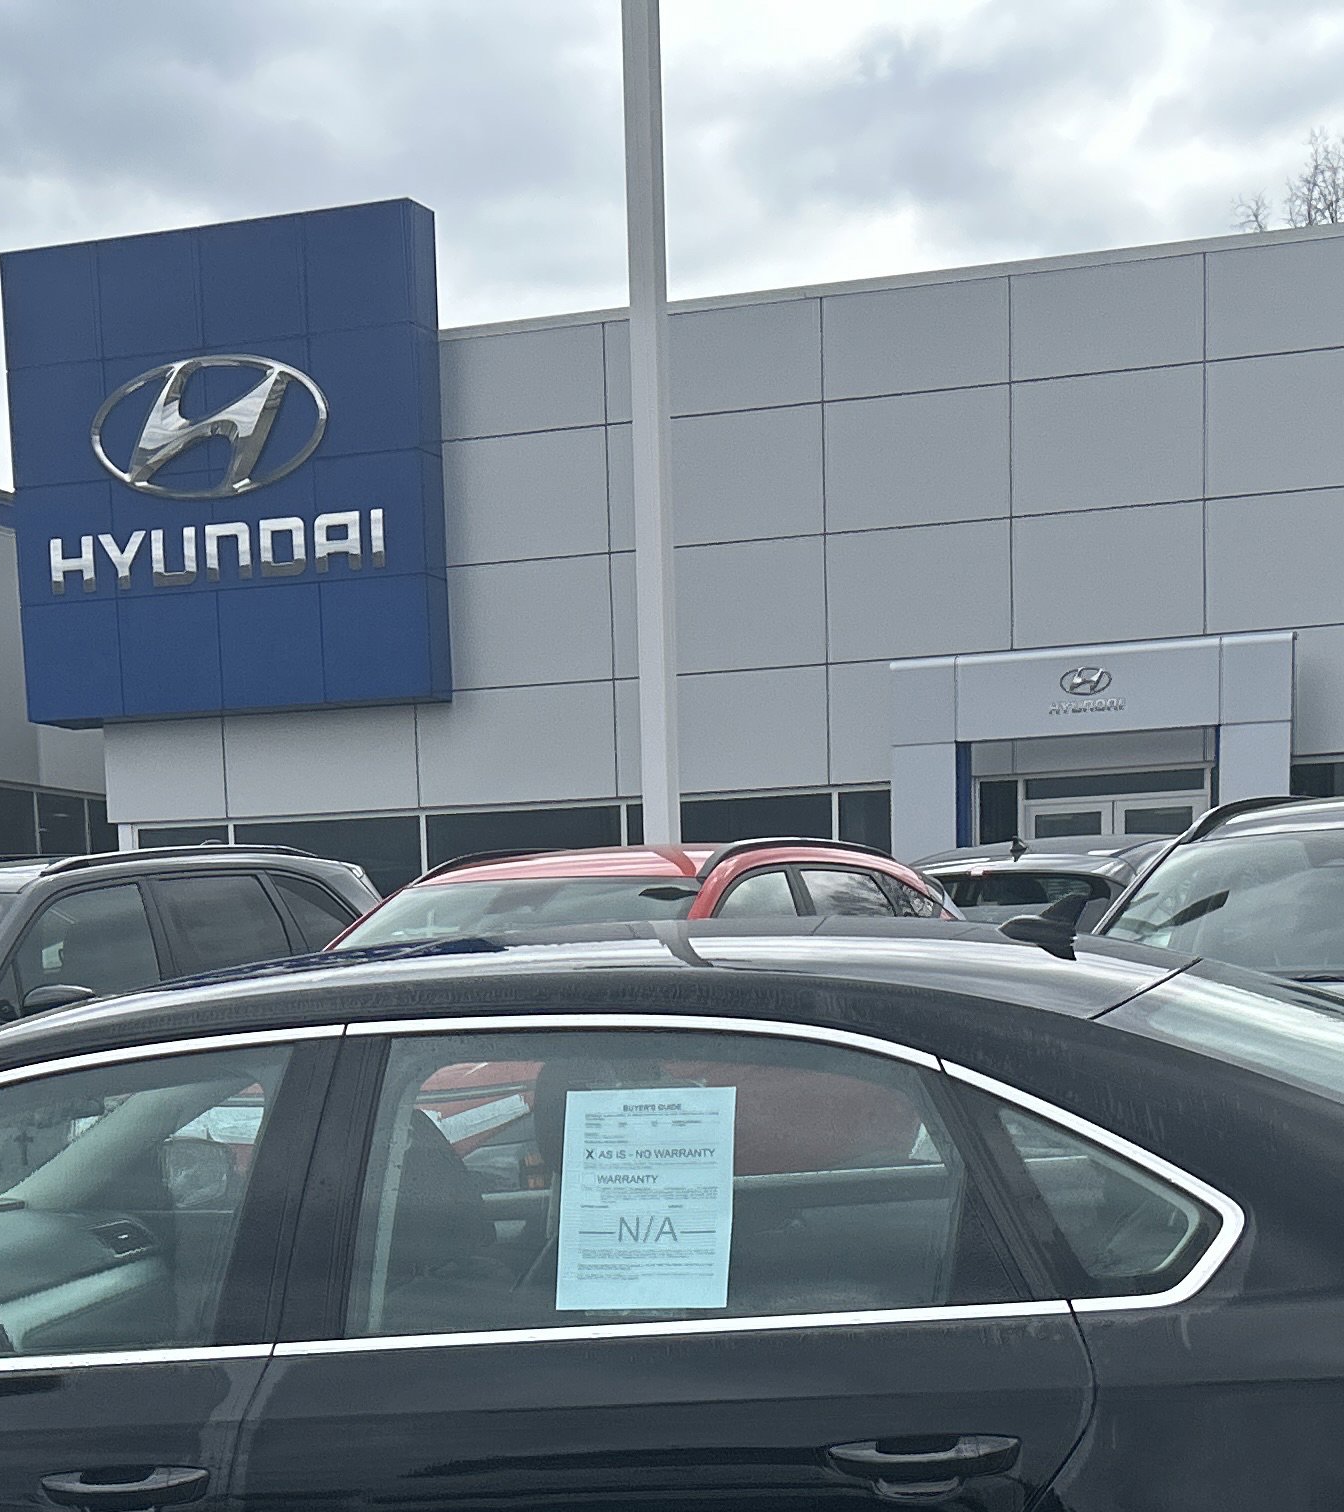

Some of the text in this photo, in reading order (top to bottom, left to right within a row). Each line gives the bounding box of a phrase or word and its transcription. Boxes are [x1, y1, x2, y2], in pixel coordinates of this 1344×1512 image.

[49, 508, 386, 595] HYUNDAI
[585, 1149, 594, 1159] X
[598, 1150, 613, 1159] AS
[616, 1149, 626, 1159] IS
[636, 1149, 652, 1159] NO
[654, 1148, 715, 1159] WARRANTY
[597, 1174, 658, 1184] WARRANTY
[618, 1215, 678, 1243] N/A
